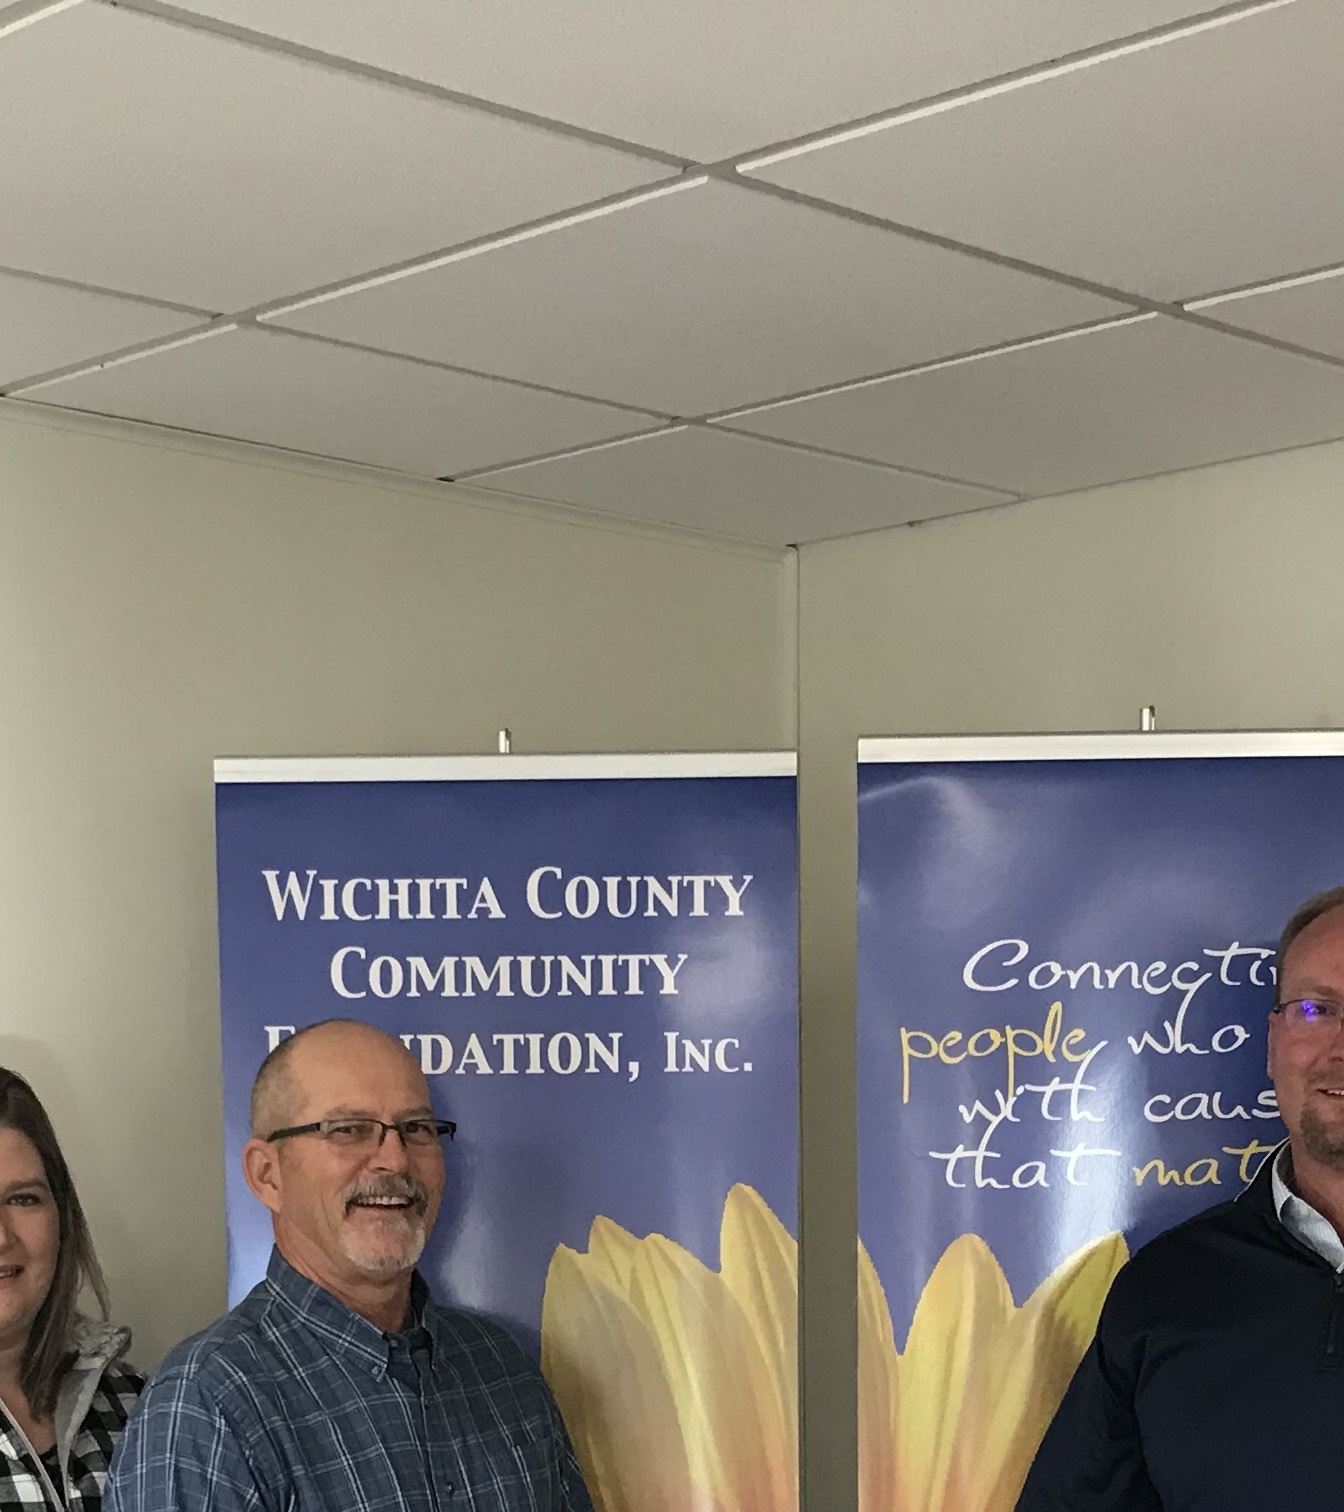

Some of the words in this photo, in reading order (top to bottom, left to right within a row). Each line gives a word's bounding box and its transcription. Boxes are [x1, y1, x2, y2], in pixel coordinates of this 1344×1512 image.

[262, 869, 506, 921] WICHITA
[526, 867, 753, 918] COUNTY
[330, 946, 688, 998] COMMUNITY
[962, 938, 1277, 995] Connecti
[899, 1001, 1093, 1104] people
[1127, 971, 1251, 1055] who
[958, 1041, 1109, 1125] with
[929, 1108, 1121, 1189] that
